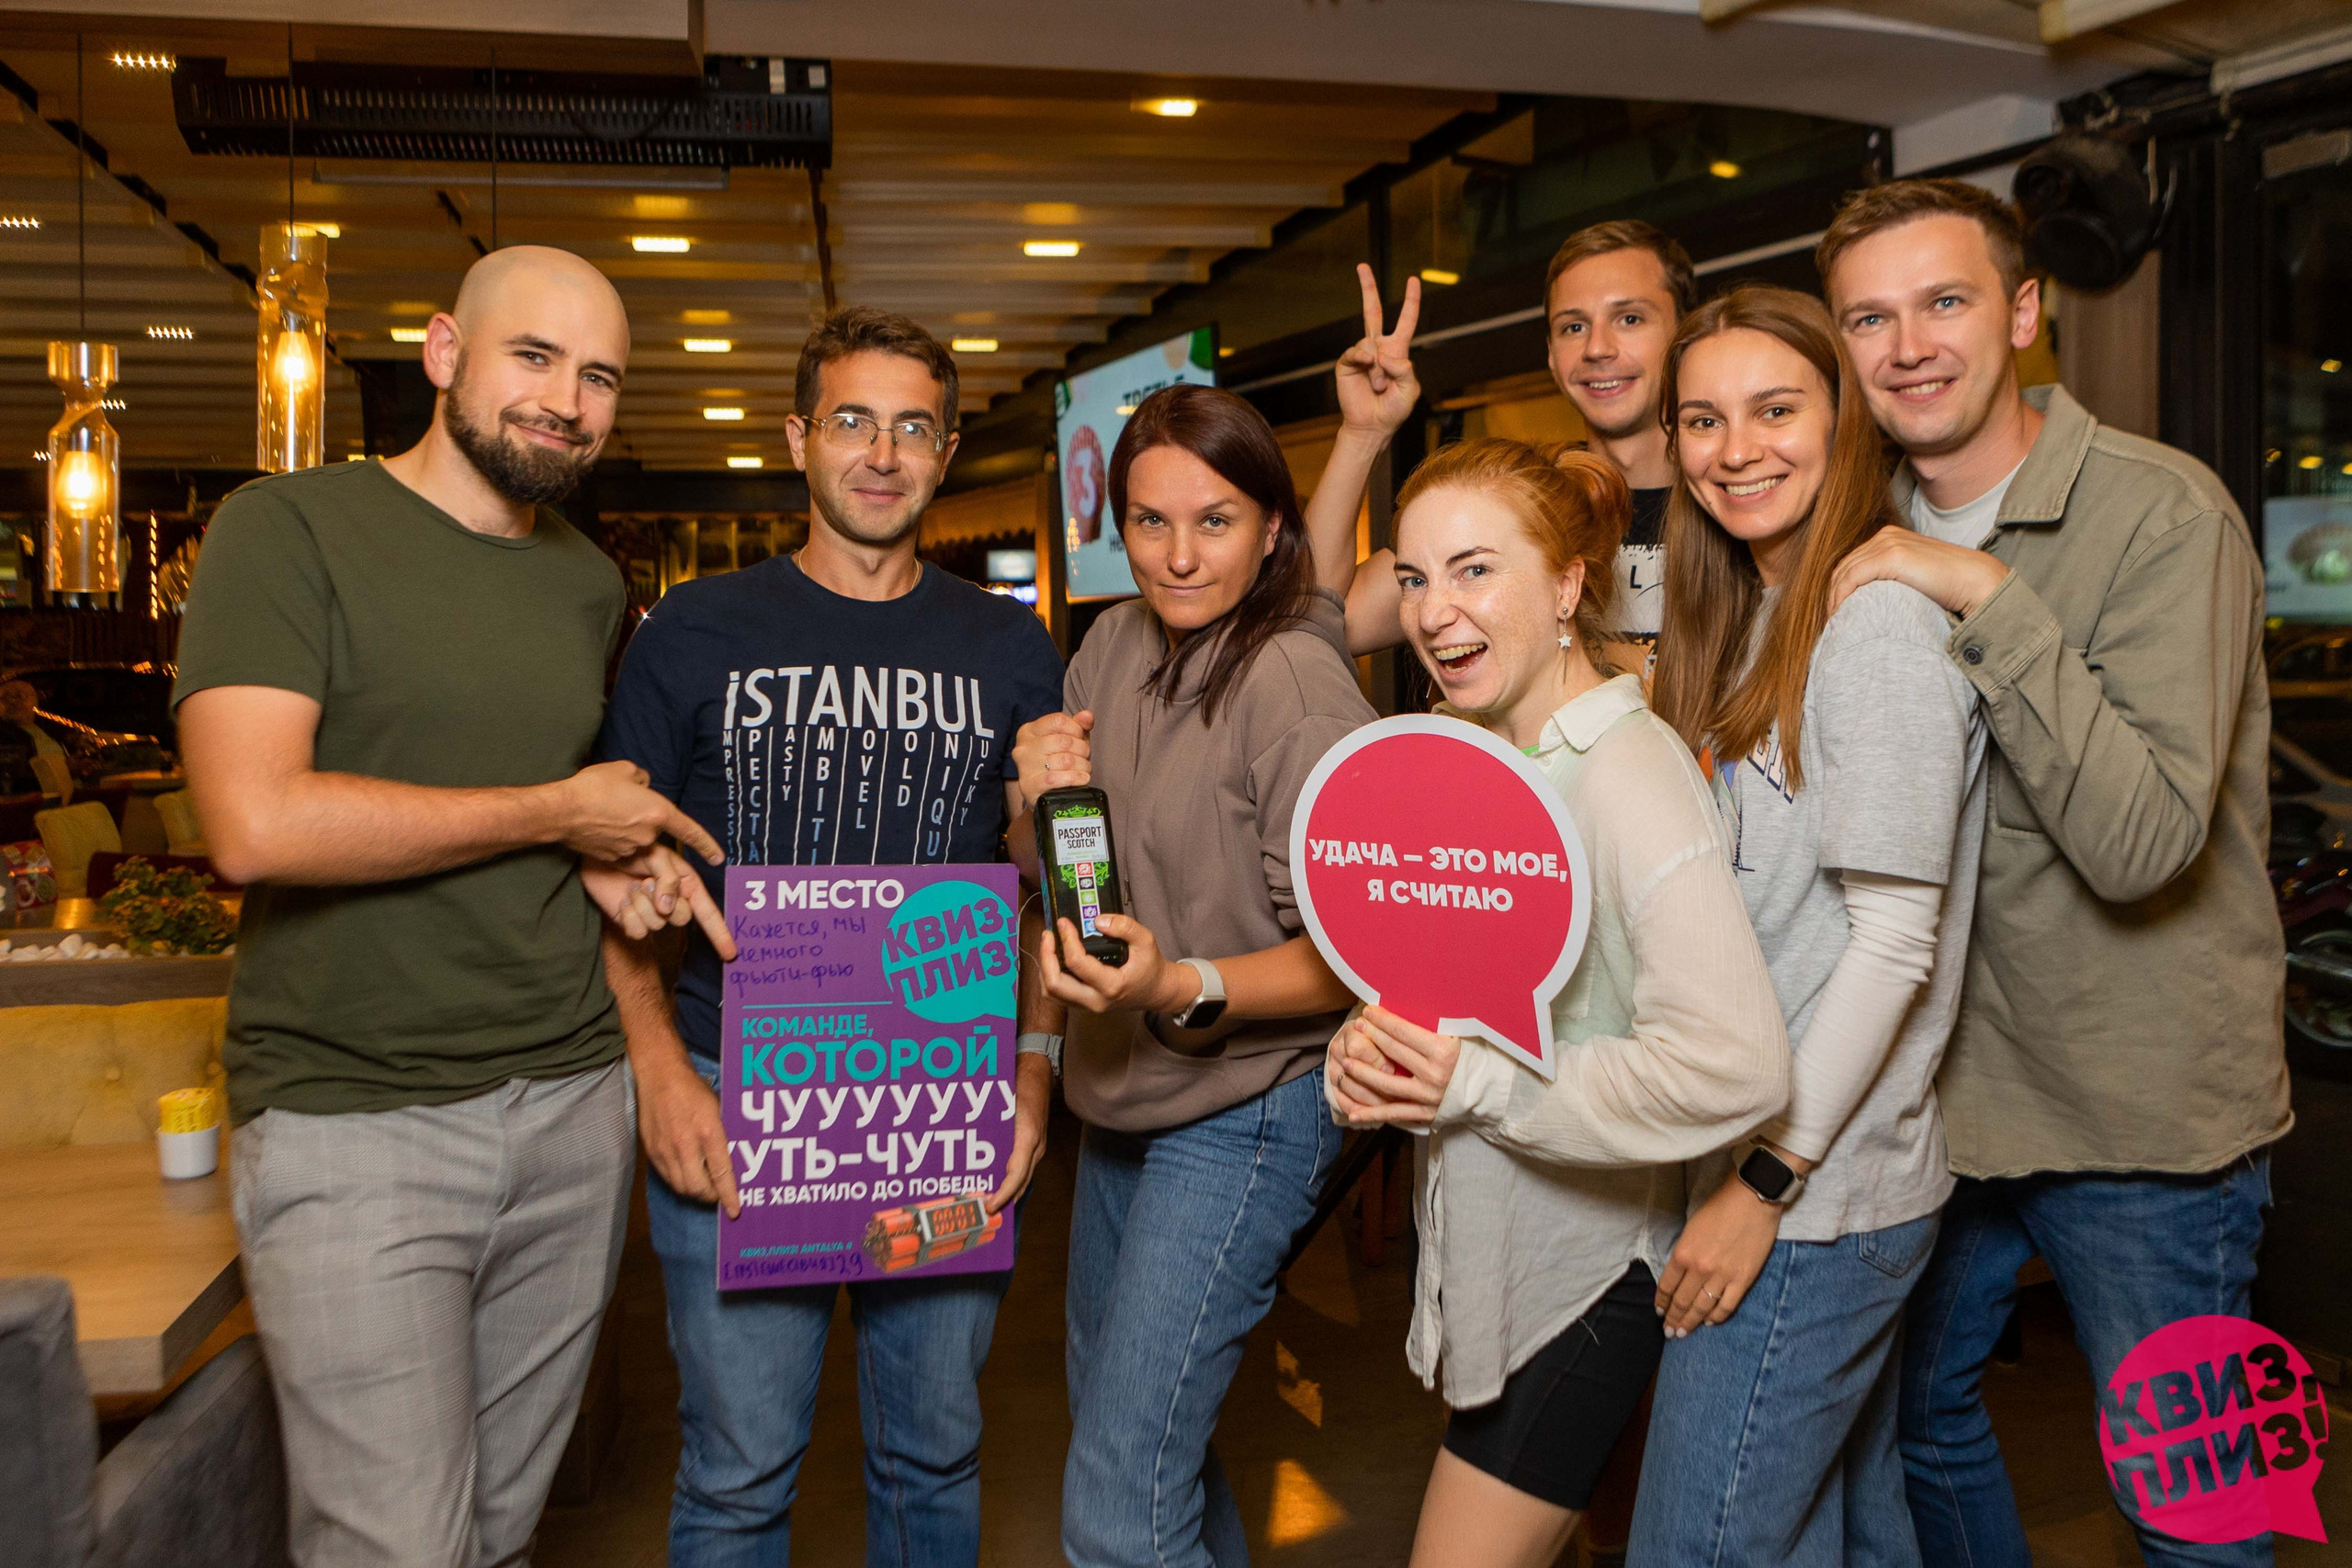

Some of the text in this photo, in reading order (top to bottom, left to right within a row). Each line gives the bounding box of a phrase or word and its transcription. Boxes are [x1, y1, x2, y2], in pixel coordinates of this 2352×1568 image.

[1057, 826, 1102, 840] PASSPORT
[1067, 839, 1095, 850] SCOTCH
[1308, 838, 1398, 867] УДАЧА
[1429, 846, 1487, 873] ЭТО
[1494, 850, 1567, 883] МОЕ,
[745, 878, 905, 910] 3 МЕСТО
[1367, 879, 1513, 912] Я СЧИТАЮ
[733, 915, 866, 941] Кажется, мы
[737, 944, 823, 963] немного
[741, 1014, 874, 1038] КОМАНДЕ,
[741, 1024, 998, 1087] КОТОРОЙ
[739, 1174, 994, 1207] НЕ ХВАТИЛО ДО ПОБЕДЫ
